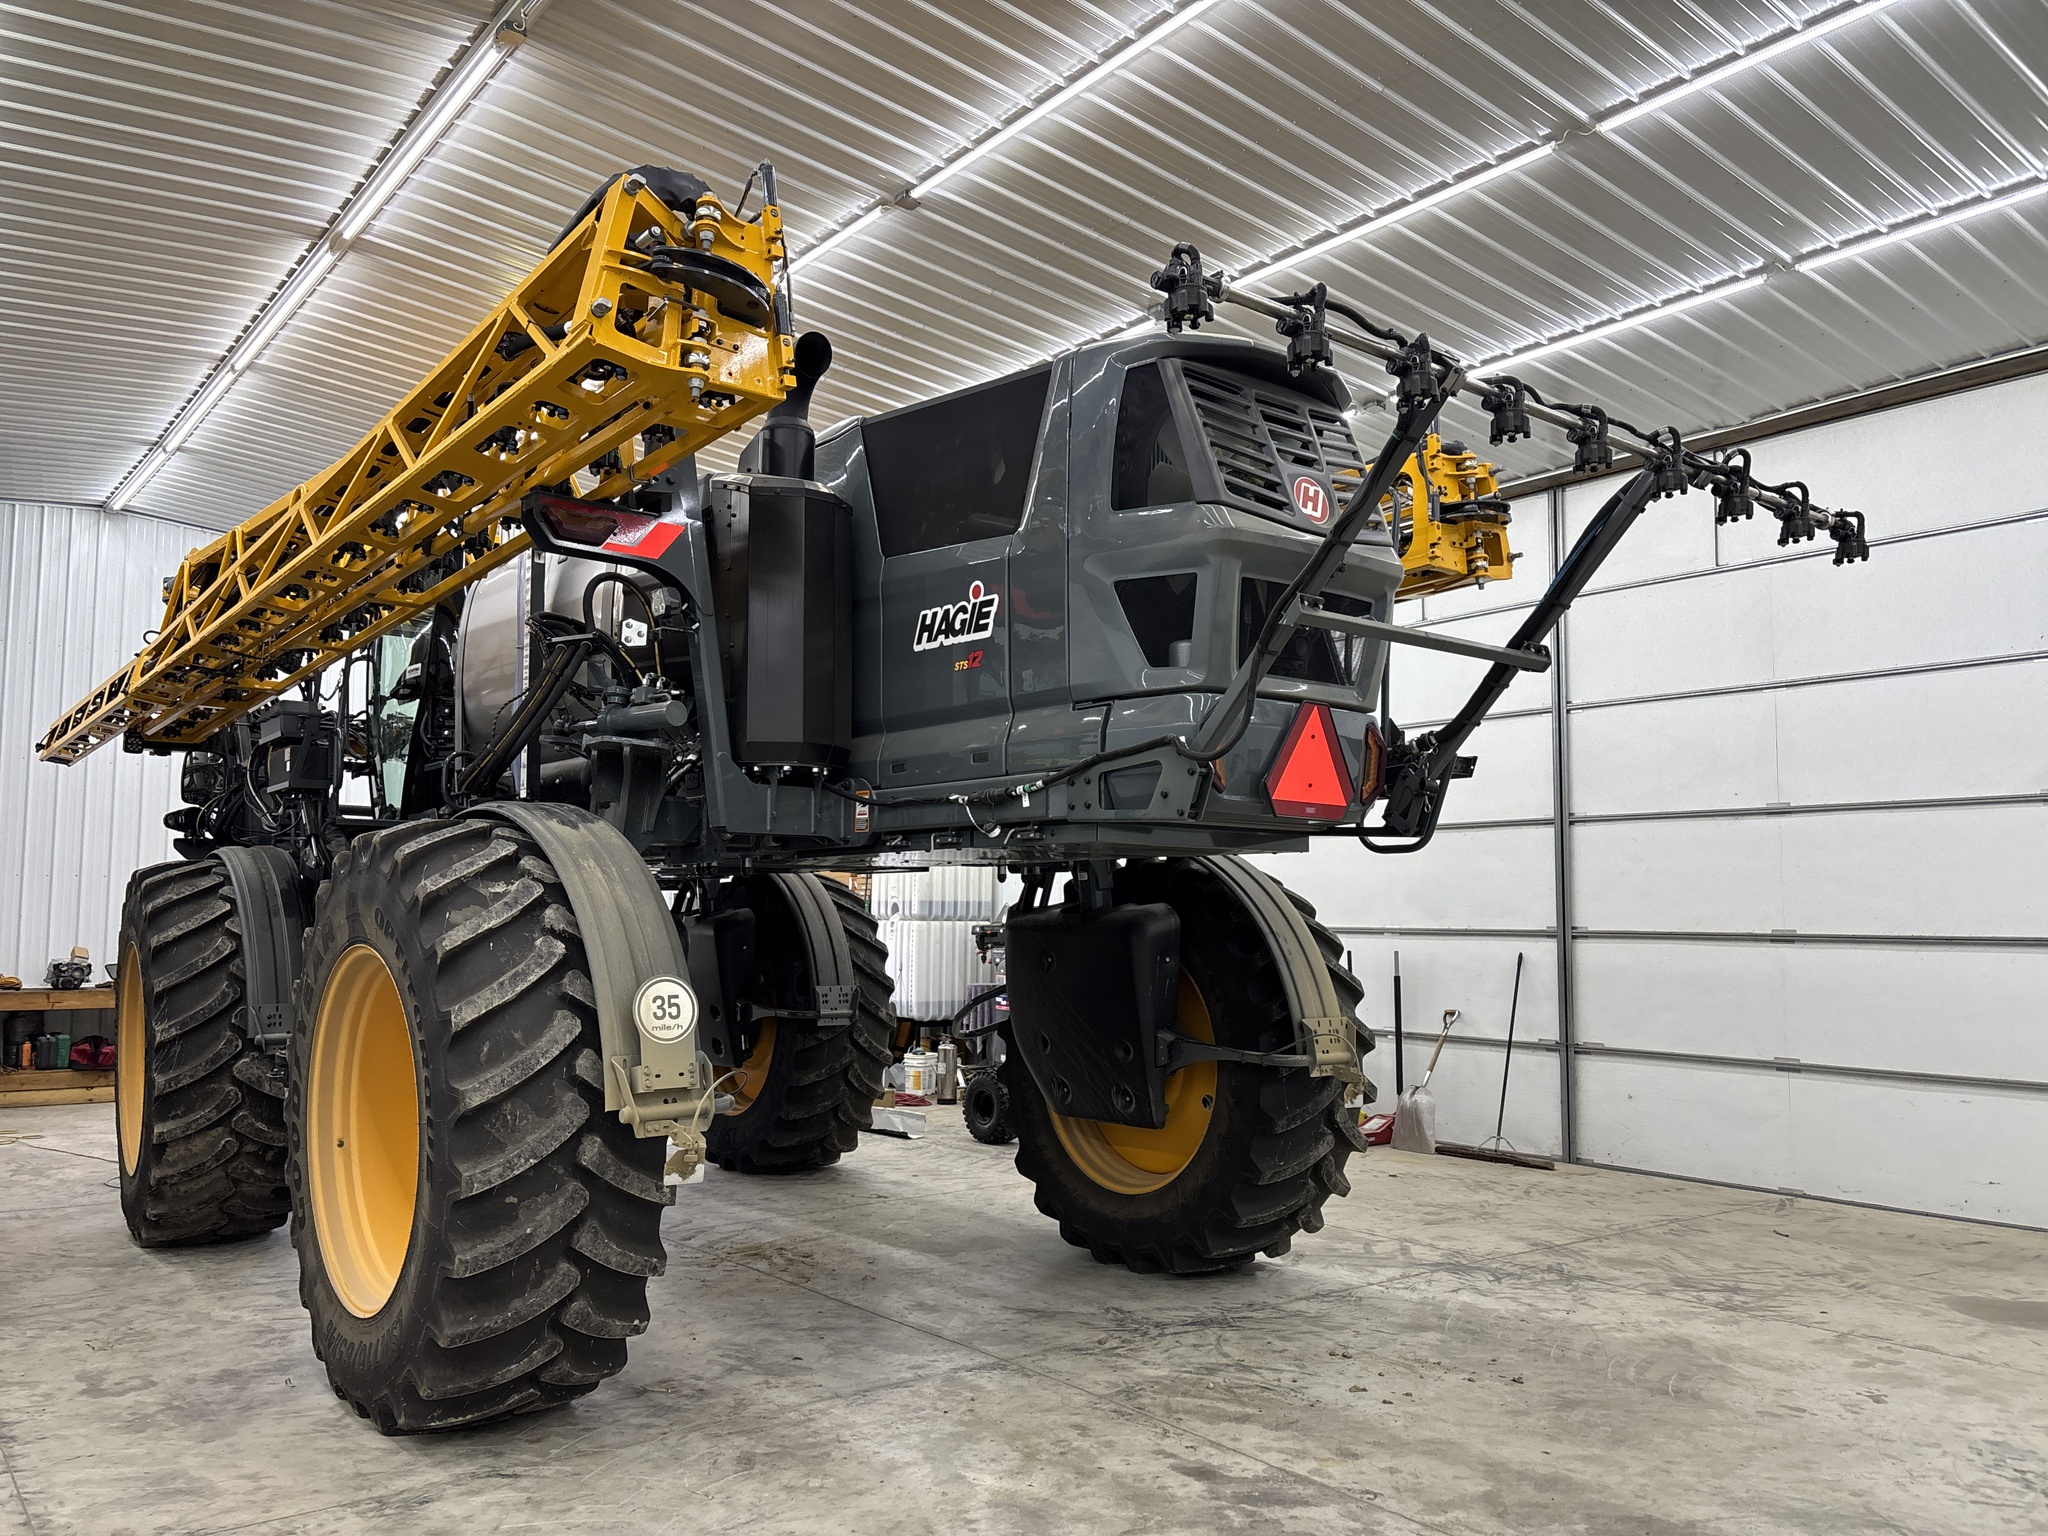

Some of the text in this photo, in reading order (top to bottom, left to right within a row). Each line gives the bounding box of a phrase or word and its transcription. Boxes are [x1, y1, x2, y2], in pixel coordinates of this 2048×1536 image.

[914, 582, 997, 648] HAGIE
[651, 1023, 683, 1032] mile/h
[652, 994, 681, 1020] 35
[292, 916, 335, 1232] GOODYEAR
